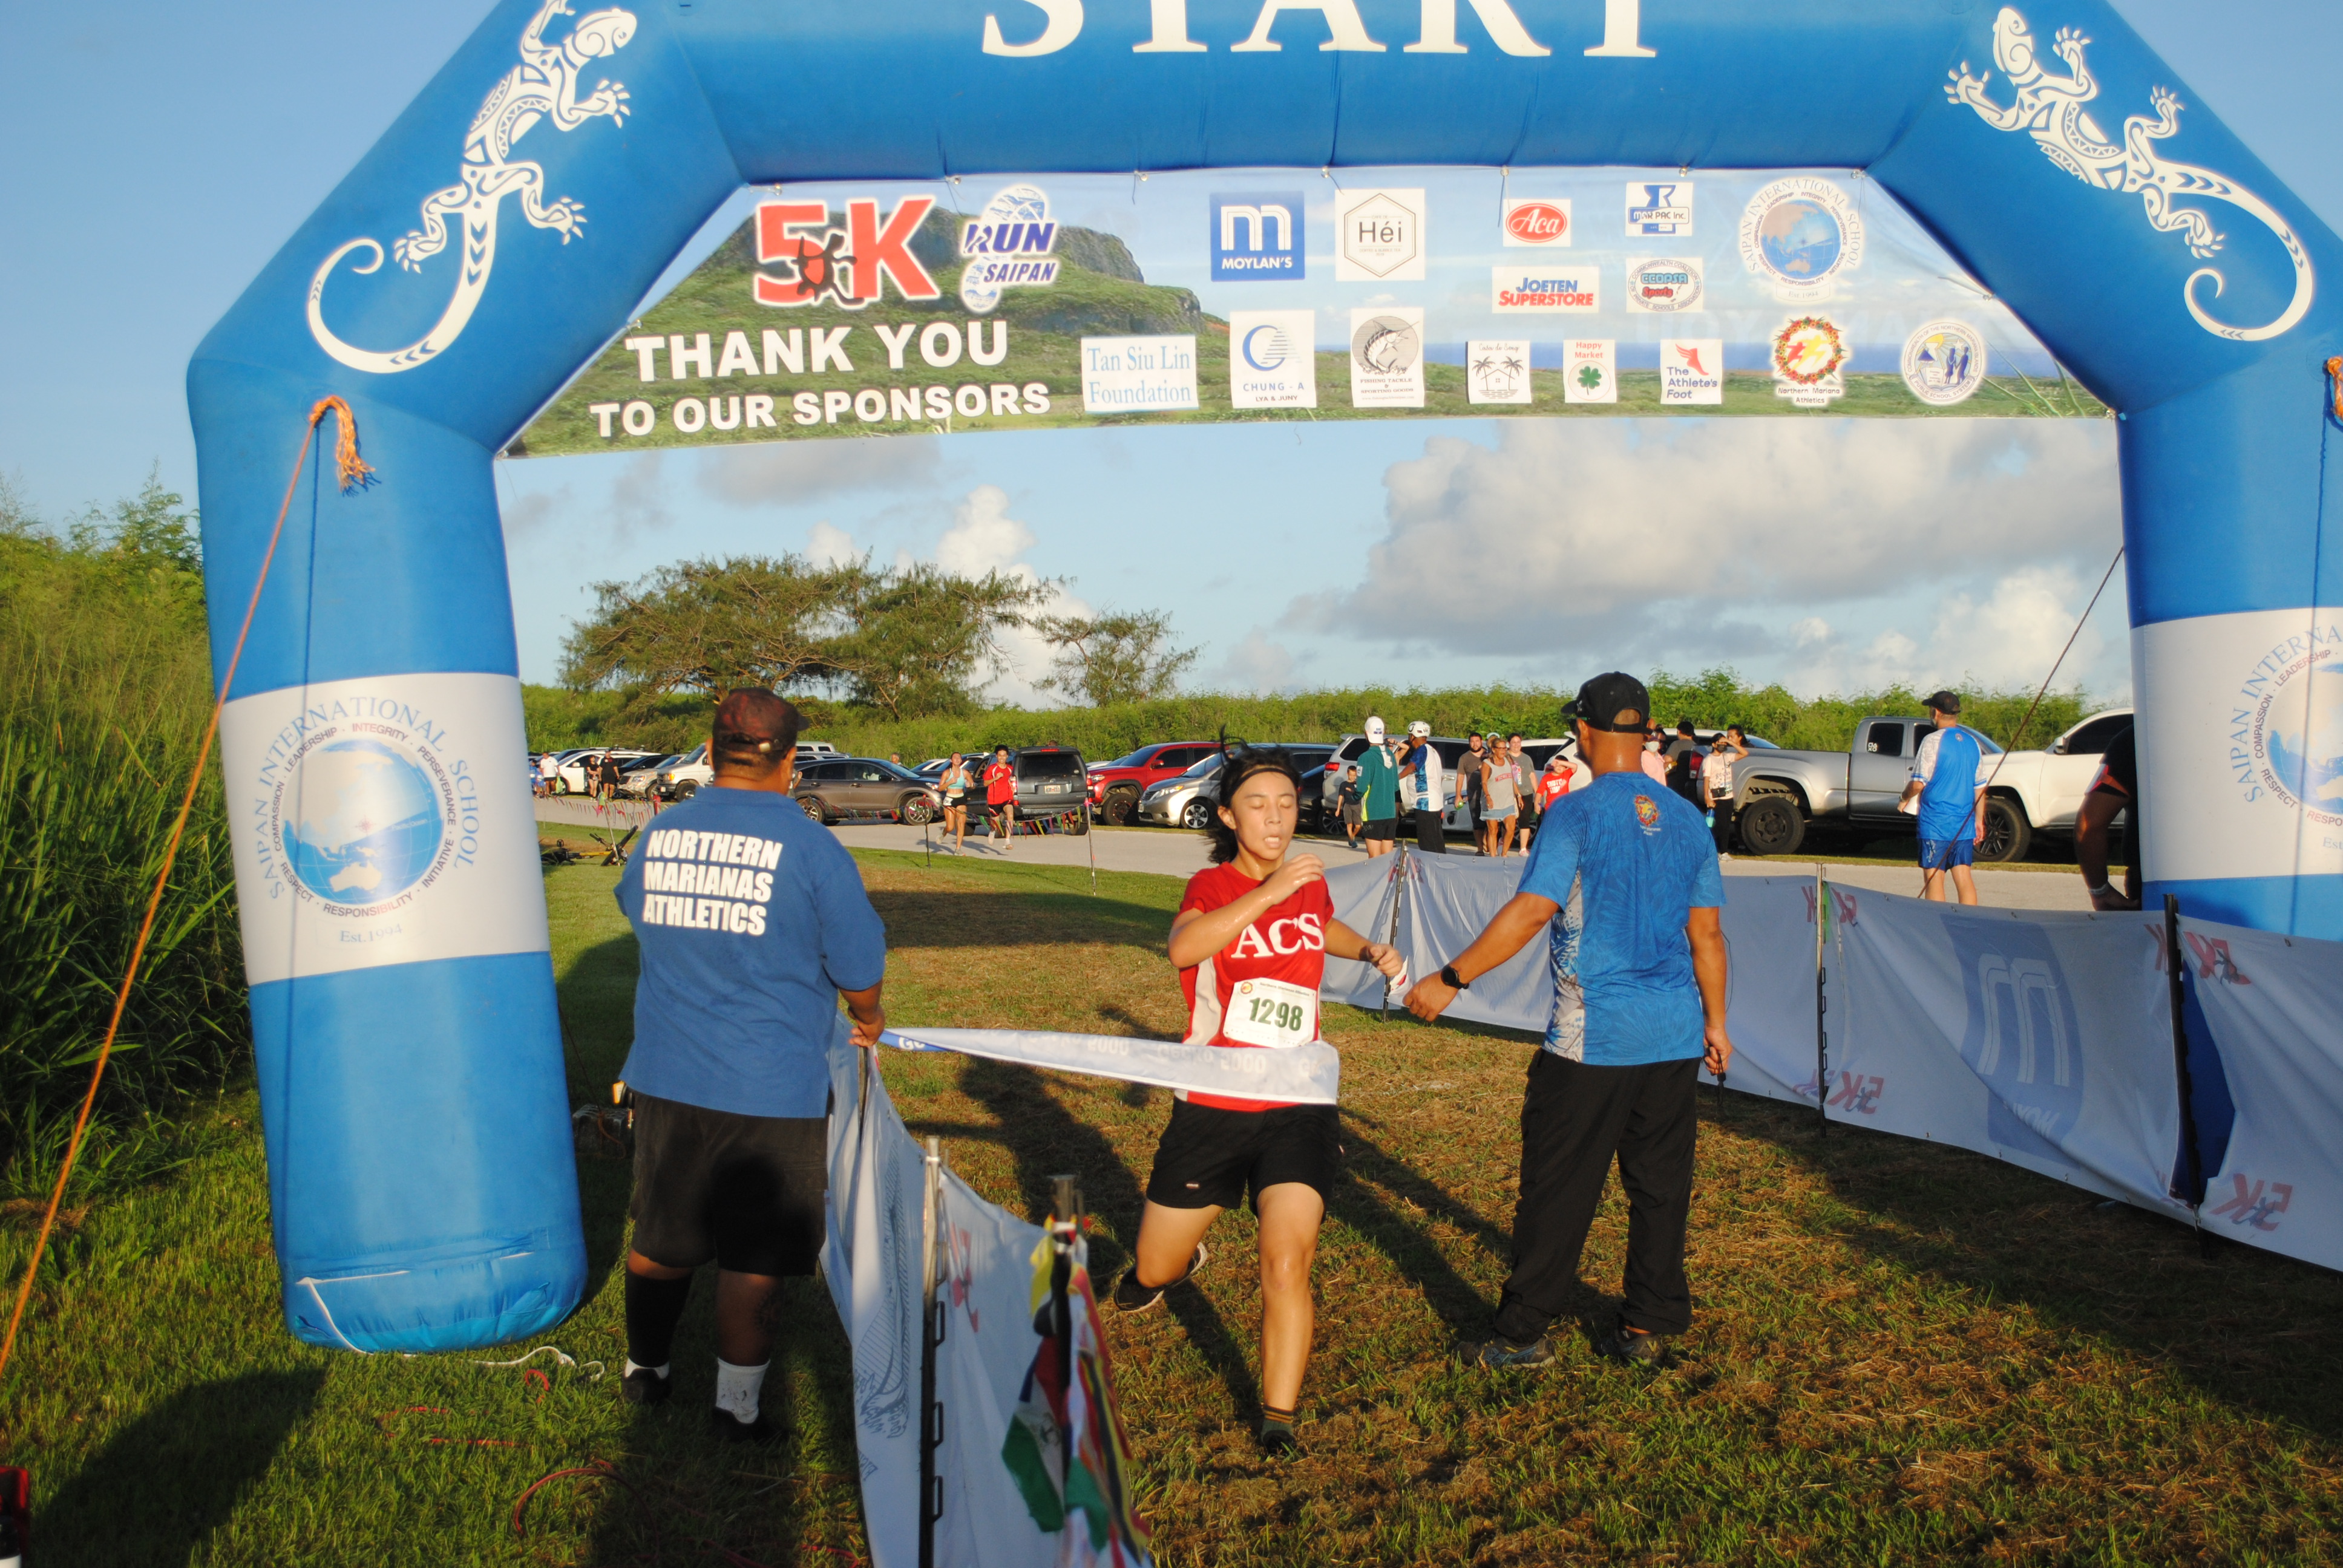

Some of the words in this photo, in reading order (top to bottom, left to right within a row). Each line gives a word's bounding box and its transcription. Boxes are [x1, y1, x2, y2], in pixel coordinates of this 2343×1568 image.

[1748, 179, 1844, 216] INTERNATIONAL
[1801, 192, 1826, 203] INTEGRITY
[1358, 221, 1401, 243] Héi
[1511, 209, 1559, 234] Aca
[757, 199, 939, 303] 5K
[963, 223, 1055, 253] RUN
[1742, 220, 1759, 271] SAIPAN
[1845, 214, 1860, 267] SCHOOL
[983, 263, 1056, 283] SAIPAN
[1222, 257, 1293, 269] MOYLAN'S
[1632, 261, 1673, 279] COMMONWEALTH
[1674, 261, 1697, 279] COALITION
[1640, 273, 1688, 284] CCOPSA
[1498, 290, 1593, 306] SUPERSTORE
[1516, 277, 1578, 293] JOETEN
[1634, 293, 1649, 308] PRIVATE
[1642, 286, 1673, 299] Sports
[626, 326, 851, 382] THANK
[874, 320, 1008, 369] YOU
[1087, 347, 1121, 371] Tan
[1127, 345, 1154, 370] Siu
[1161, 345, 1190, 370] Lin
[1576, 341, 1602, 350] Happy
[1243, 382, 1285, 391] CHUNG
[1666, 367, 1689, 375] The
[1668, 377, 1717, 387] Athlete's
[1089, 379, 1191, 403] Foundation
[1666, 390, 1692, 399] Foot
[1915, 381, 1928, 395] PUBLIC
[1953, 381, 1971, 396] SYSTEM
[589, 400, 655, 437] TO
[673, 394, 776, 433] OUR
[793, 382, 1050, 425] SPONSORS
[2253, 694, 2273, 759] COMPASSION
[2275, 649, 2331, 687] LEADERSHIP
[260, 697, 447, 788] INTERNATIONAL
[352, 723, 409, 742] INTEGRITY
[284, 727, 337, 773] LEADERSHIP
[2230, 708, 2263, 803] SAIPAN
[418, 746, 456, 825] PERSEVERANCE
[2261, 769, 2298, 808] RESPECT
[272, 782, 285, 851] COMPASSION
[450, 760, 479, 869] SCHOOL
[255, 799, 285, 899] SAIPAN
[422, 838, 454, 887] INITIATIVE
[646, 829, 783, 870] NORTHERN
[280, 862, 314, 903] RESPECT
[644, 861, 773, 903] MARIANAS
[323, 892, 413, 917] RESPONSIBILITY
[643, 893, 767, 936] ATHLETICS
[1231, 913, 1324, 959] ACS
[1249, 998, 1303, 1031] 1298
